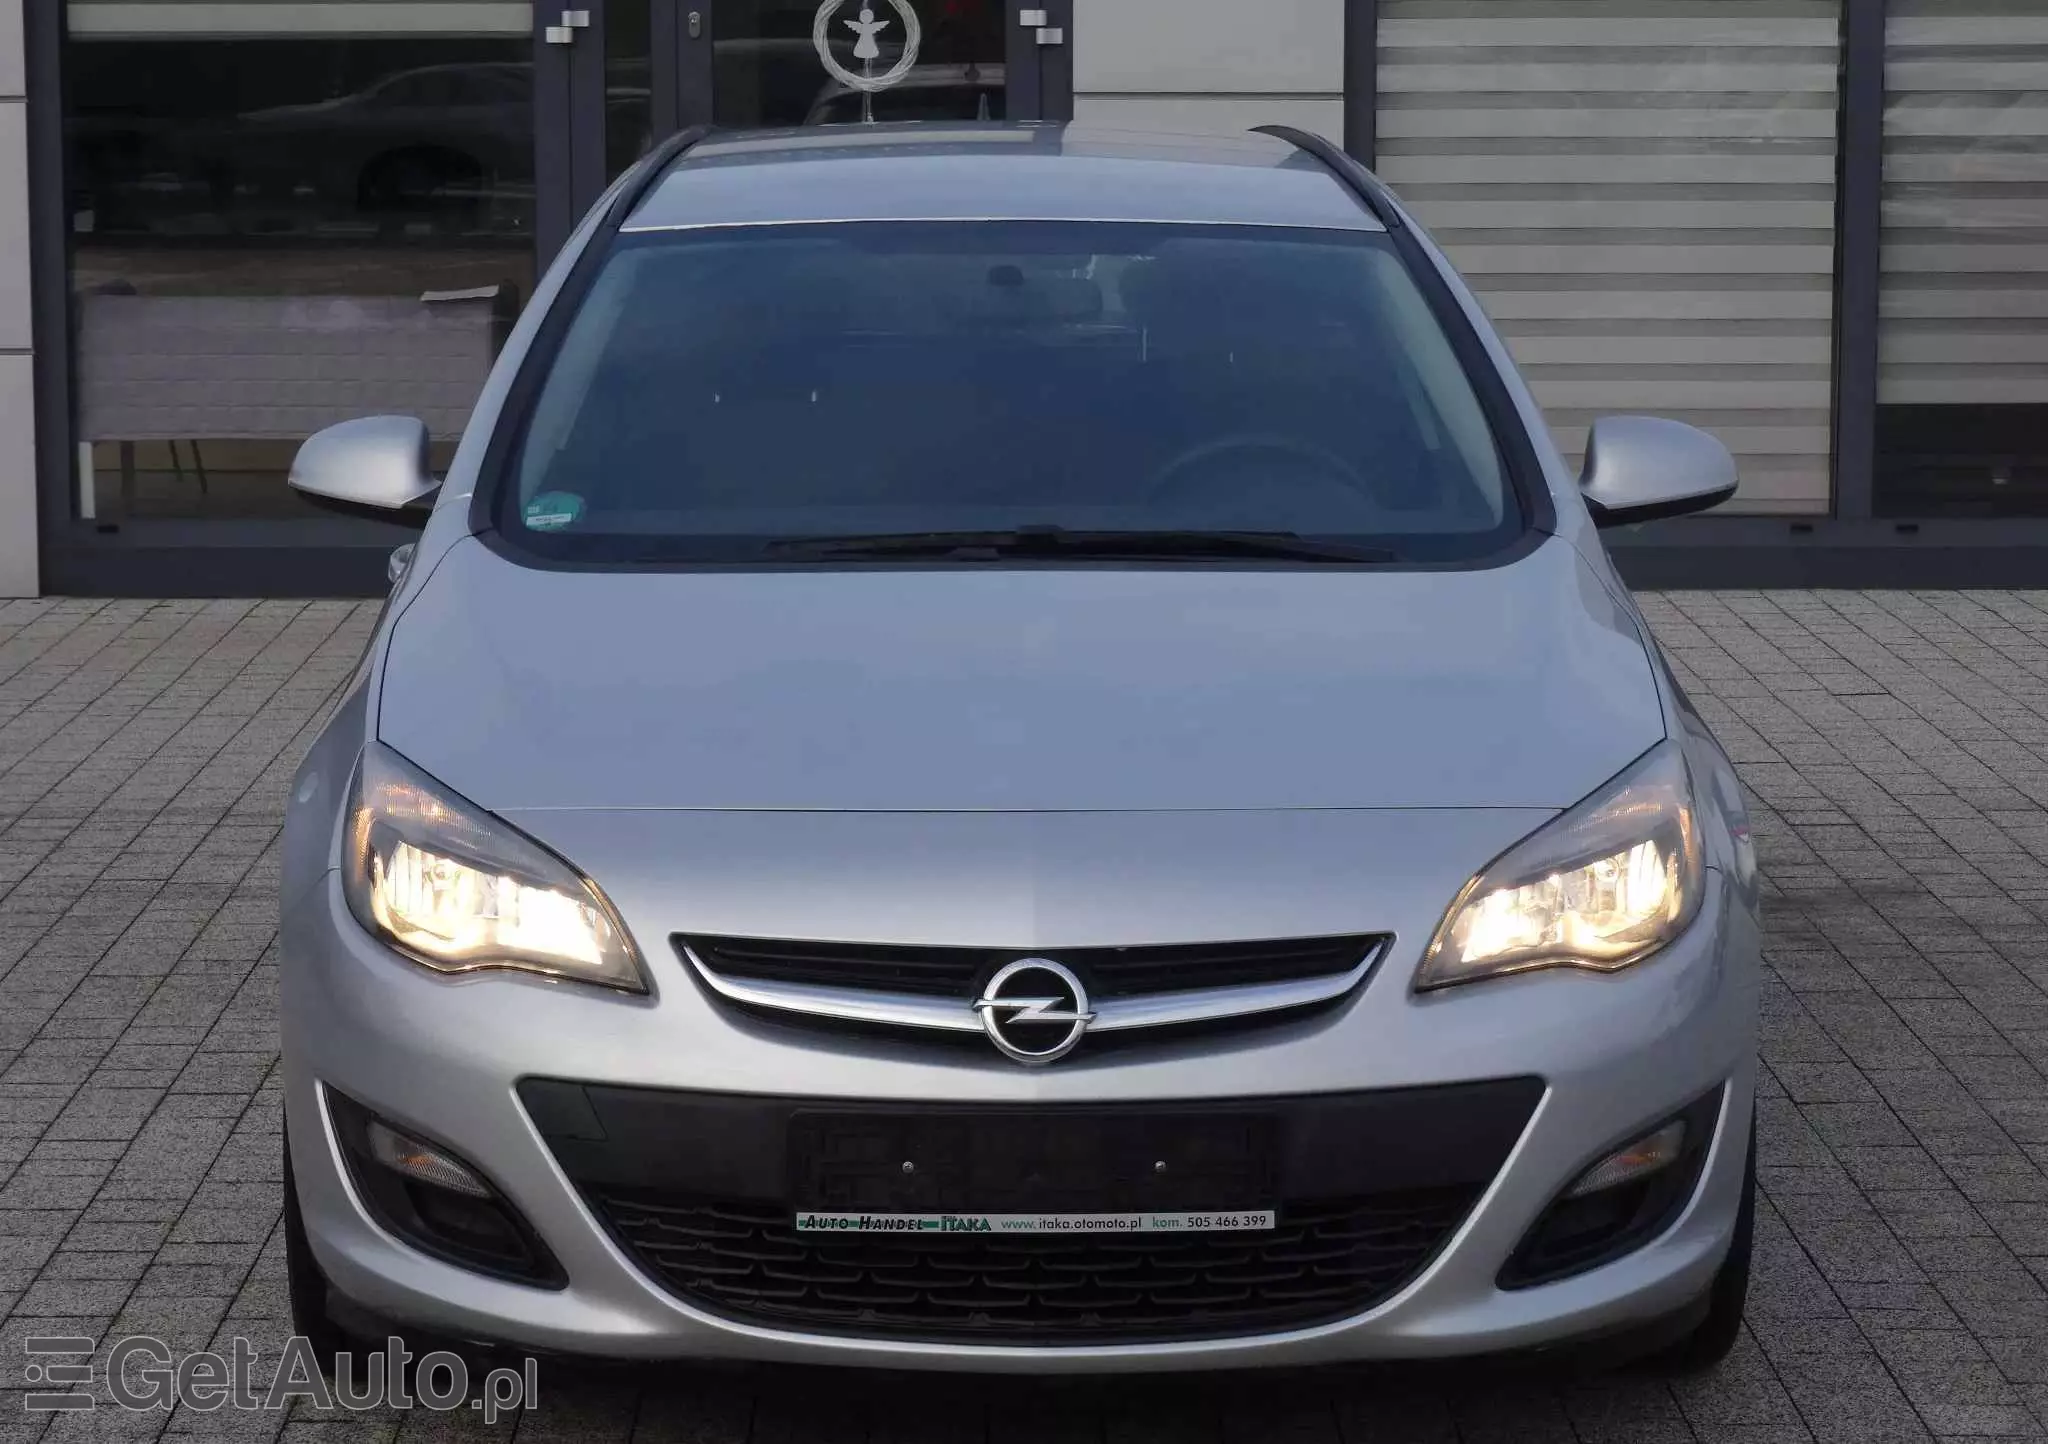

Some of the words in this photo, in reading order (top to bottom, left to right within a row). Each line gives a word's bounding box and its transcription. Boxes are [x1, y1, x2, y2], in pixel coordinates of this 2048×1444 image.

[806, 1214, 849, 1230] AUTO
[858, 1215, 924, 1231] HANDEL
[1000, 1216, 1142, 1231] www.itaka.otomoto.pl
[1152, 1216, 1183, 1228] kom.
[1187, 1215, 1211, 1228] 505
[1215, 1215, 1239, 1228] 466
[1243, 1214, 1267, 1227] 399
